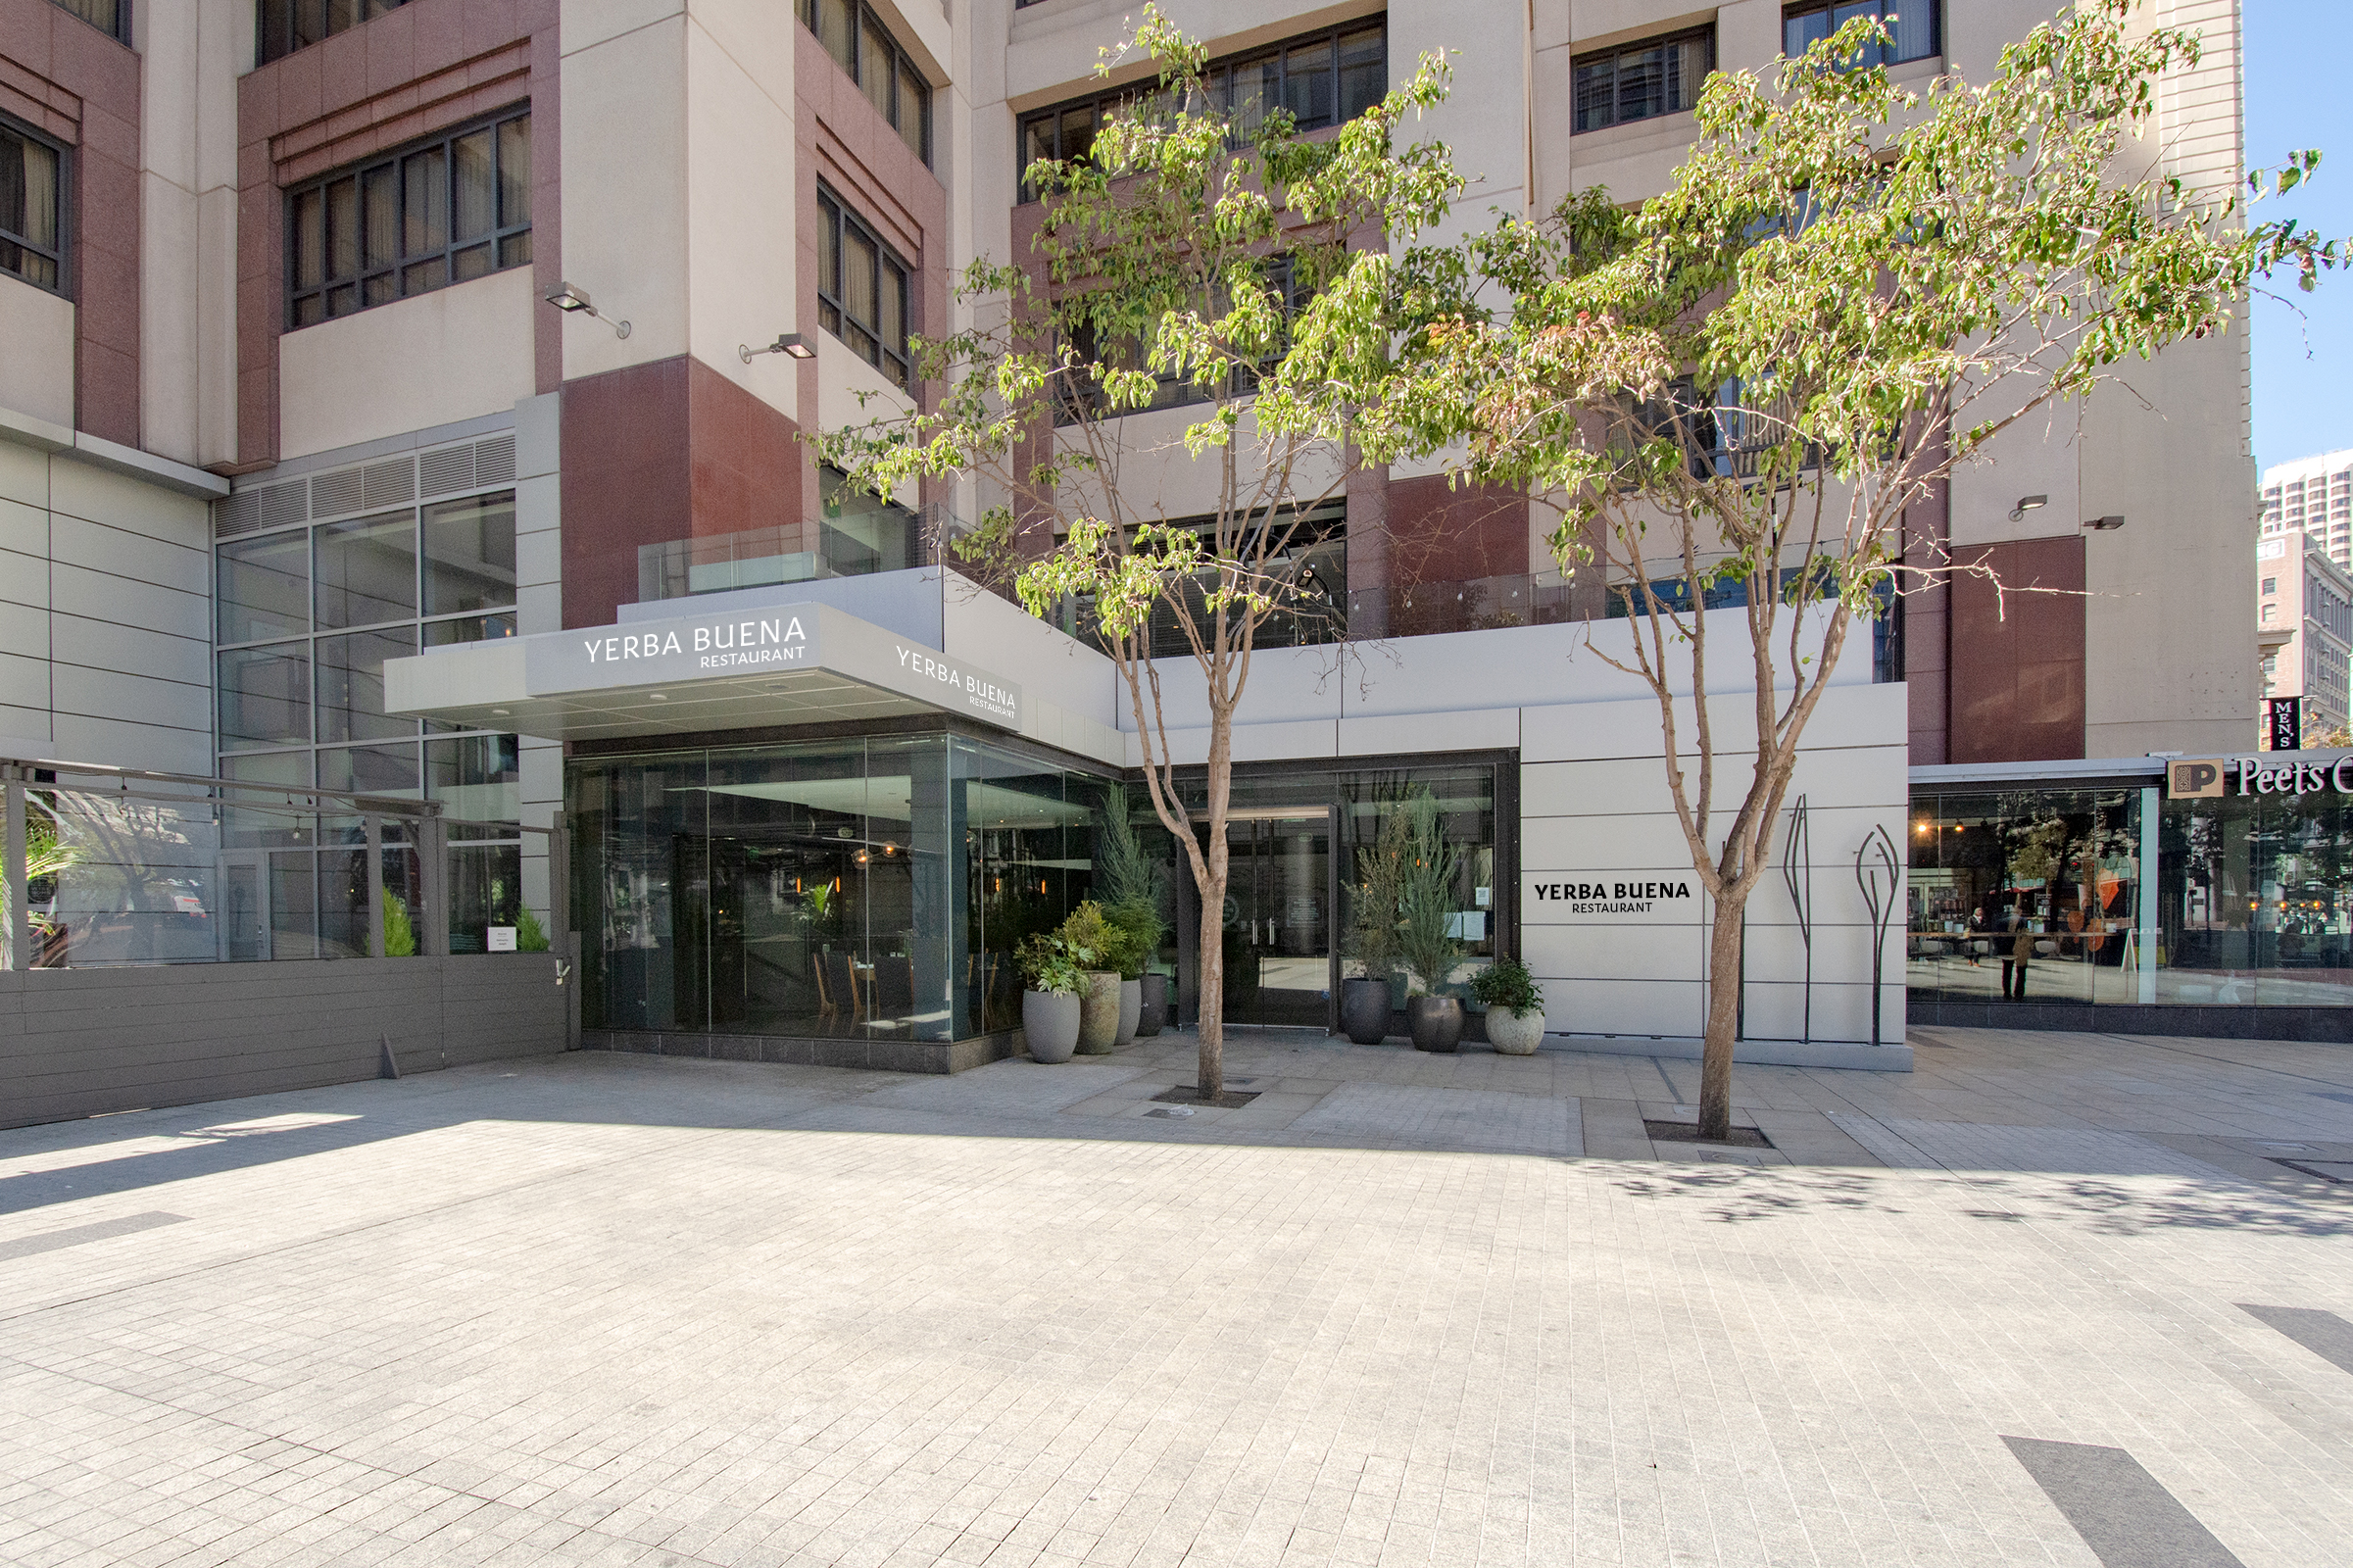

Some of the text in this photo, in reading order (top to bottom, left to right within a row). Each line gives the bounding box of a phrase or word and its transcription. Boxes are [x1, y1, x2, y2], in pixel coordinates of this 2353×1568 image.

[584, 616, 807, 663] YERBA BUENA
[701, 646, 806, 668] RESTAURANT
[896, 645, 1016, 710] YERBA BUENA
[969, 695, 1015, 719] RESTAURANT
[2233, 757, 2326, 796] Peet's
[1534, 882, 1691, 901] YERBA BUENA
[1572, 902, 1653, 913] RESTAURANT
